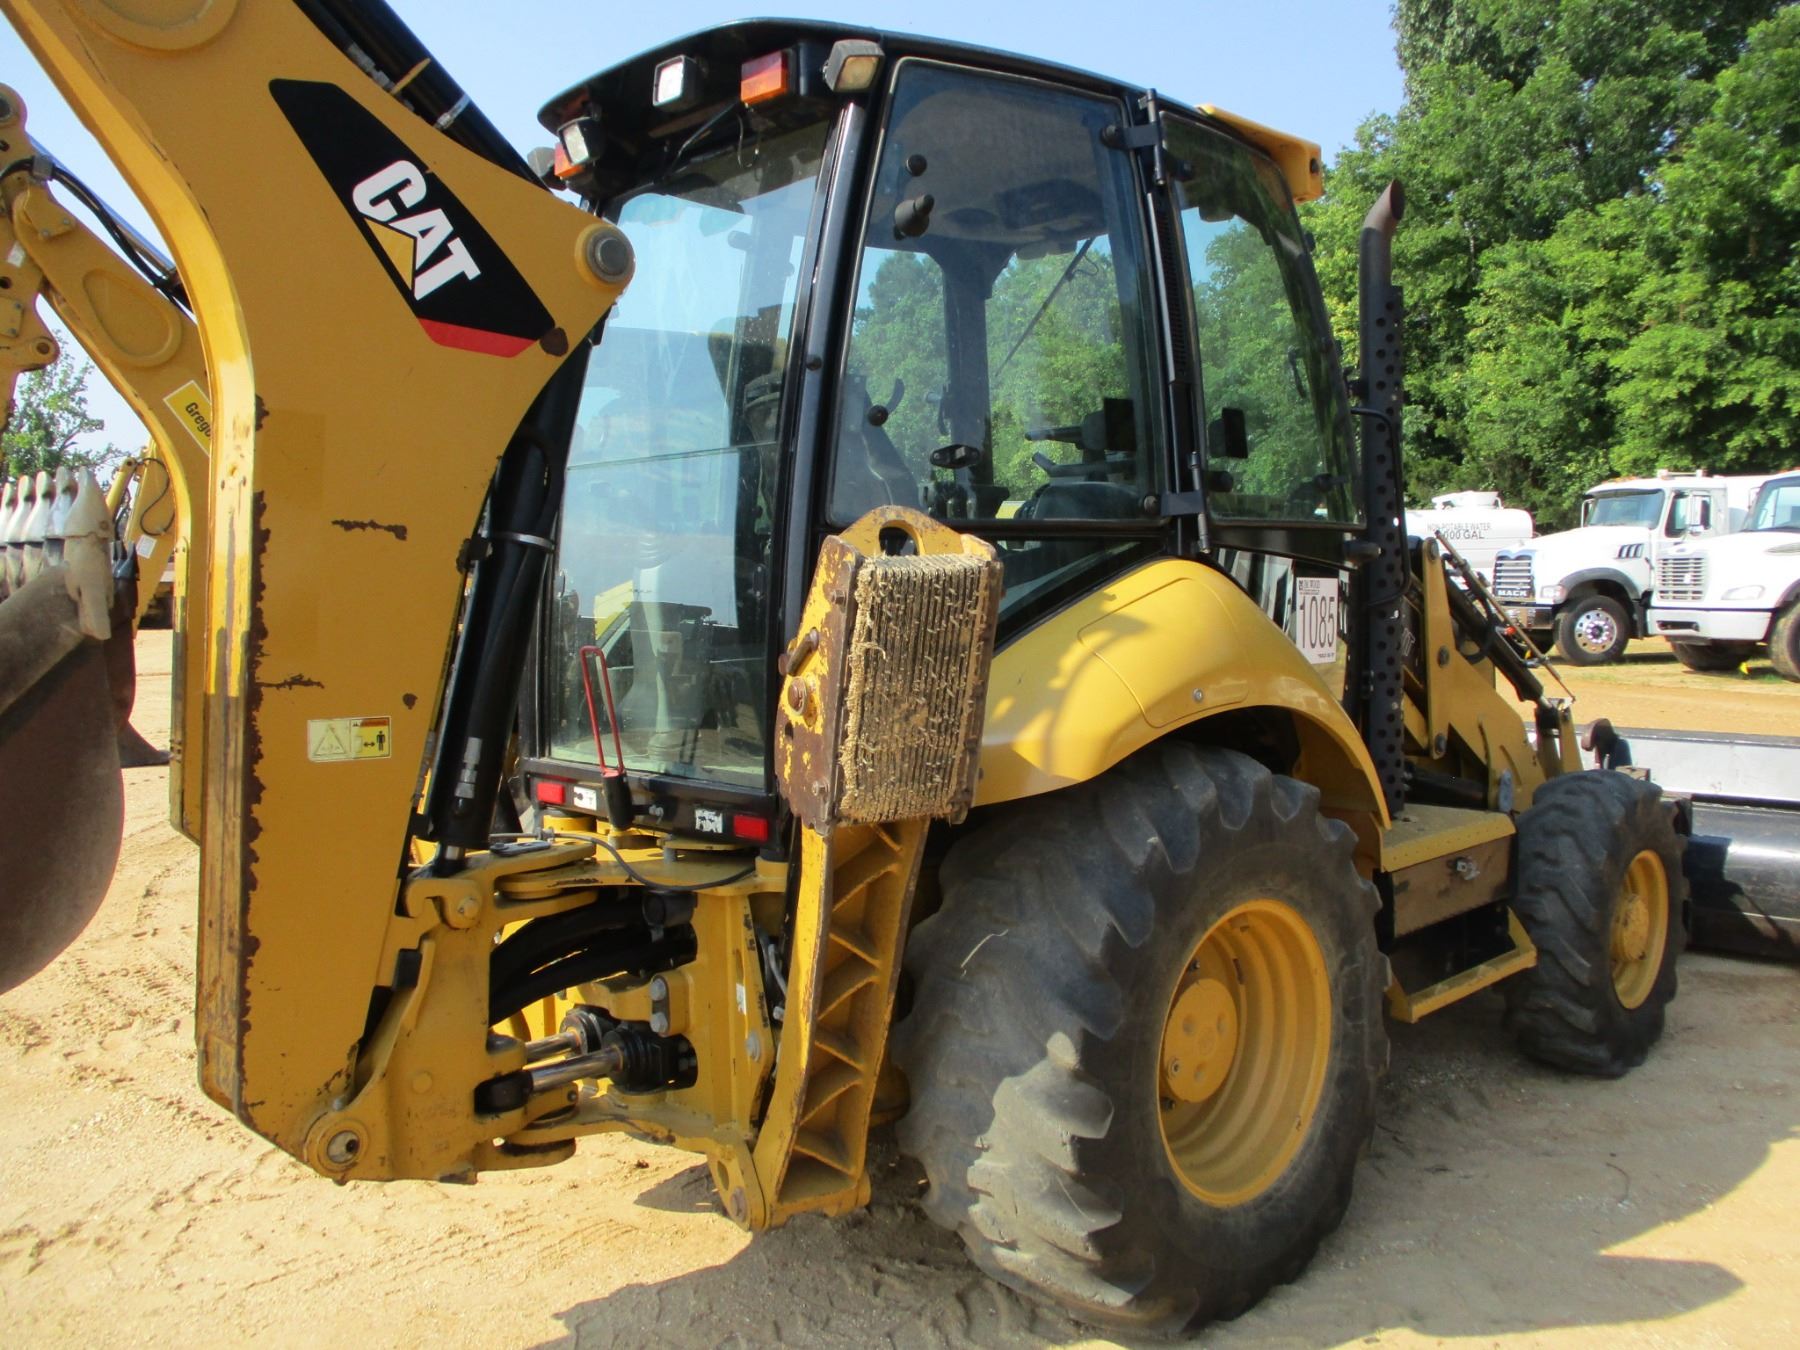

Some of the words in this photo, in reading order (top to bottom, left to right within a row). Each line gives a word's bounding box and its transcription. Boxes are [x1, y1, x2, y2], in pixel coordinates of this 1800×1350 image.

[353, 160, 481, 300] CAT
[1463, 529, 1484, 540] GAL
[1300, 595, 1335, 649] 1085
